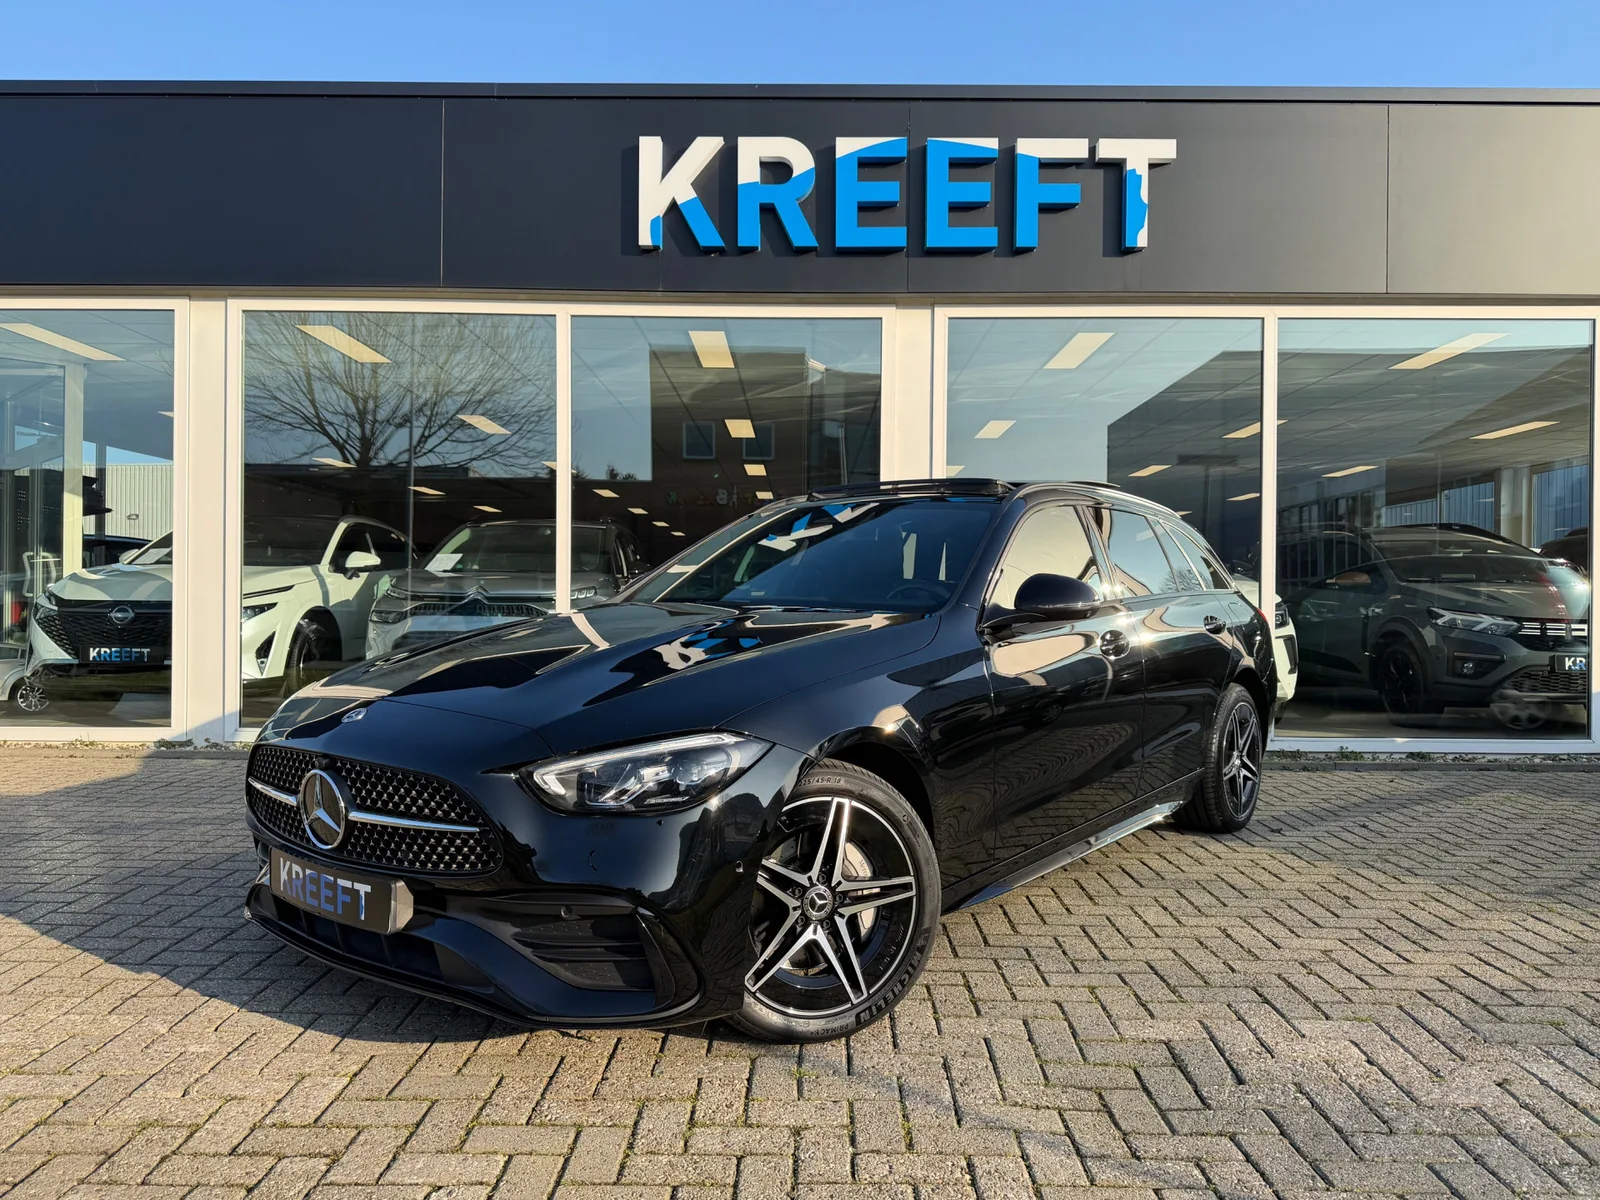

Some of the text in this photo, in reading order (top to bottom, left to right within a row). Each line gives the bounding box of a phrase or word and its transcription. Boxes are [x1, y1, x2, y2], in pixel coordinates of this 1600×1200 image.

[638, 135, 1178, 252] KREEFT
[89, 647, 151, 662] KREEFT
[799, 777, 824, 787] 225/45
[280, 857, 372, 921] KREEFT
[860, 945, 925, 1024] MICHELIN
[814, 1023, 849, 1037] PRIMACY
